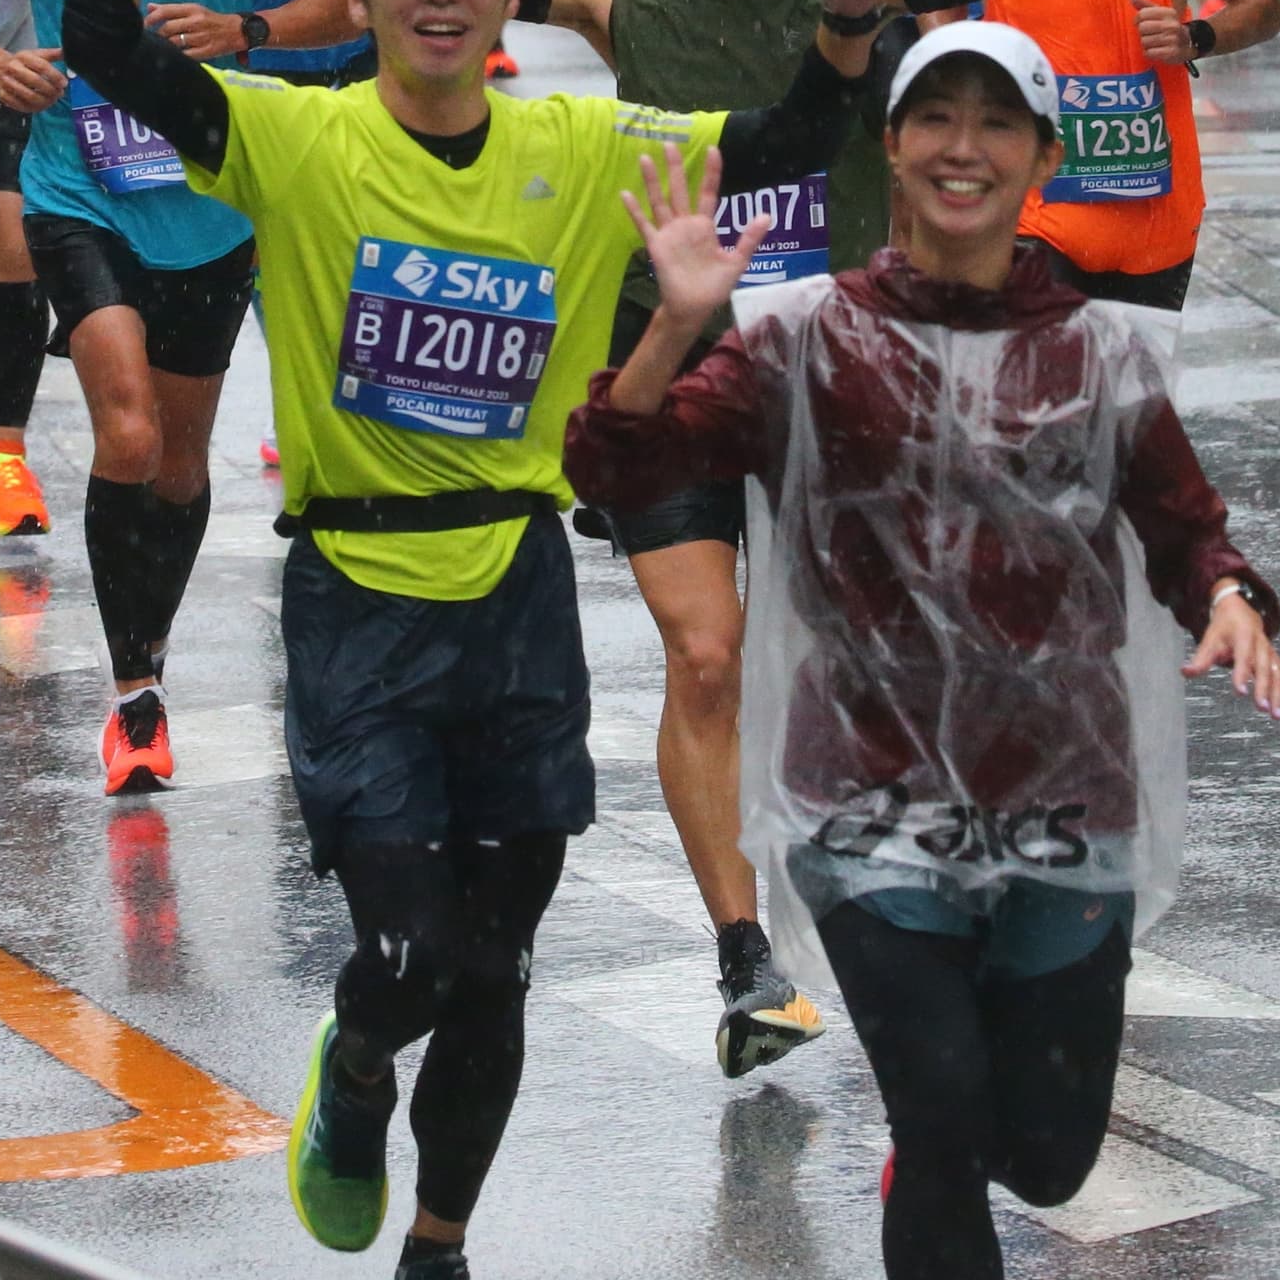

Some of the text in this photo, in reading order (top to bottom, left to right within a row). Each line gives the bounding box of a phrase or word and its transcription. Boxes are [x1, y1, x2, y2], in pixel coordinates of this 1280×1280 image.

[1095, 80, 1155, 109] Sky
[84, 119, 105, 144] B
[1076, 112, 1168, 158] 12392
[118, 148, 173, 163] TOKYO LEGACY
[1076, 165, 1102, 174] TOKYO
[1103, 163, 1131, 173] LEGACY
[1132, 162, 1151, 171] HALF
[125, 165, 164, 178] POCARI
[1081, 176, 1159, 189] POCARI SWEAT
[440, 260, 529, 312] Sky
[354, 308, 526, 379] B 12018
[385, 373, 421, 389] TOKYO
[422, 381, 459, 395] LEGACY
[460, 387, 485, 398] HALF
[386, 395, 489, 420] POCARI SWEAT
